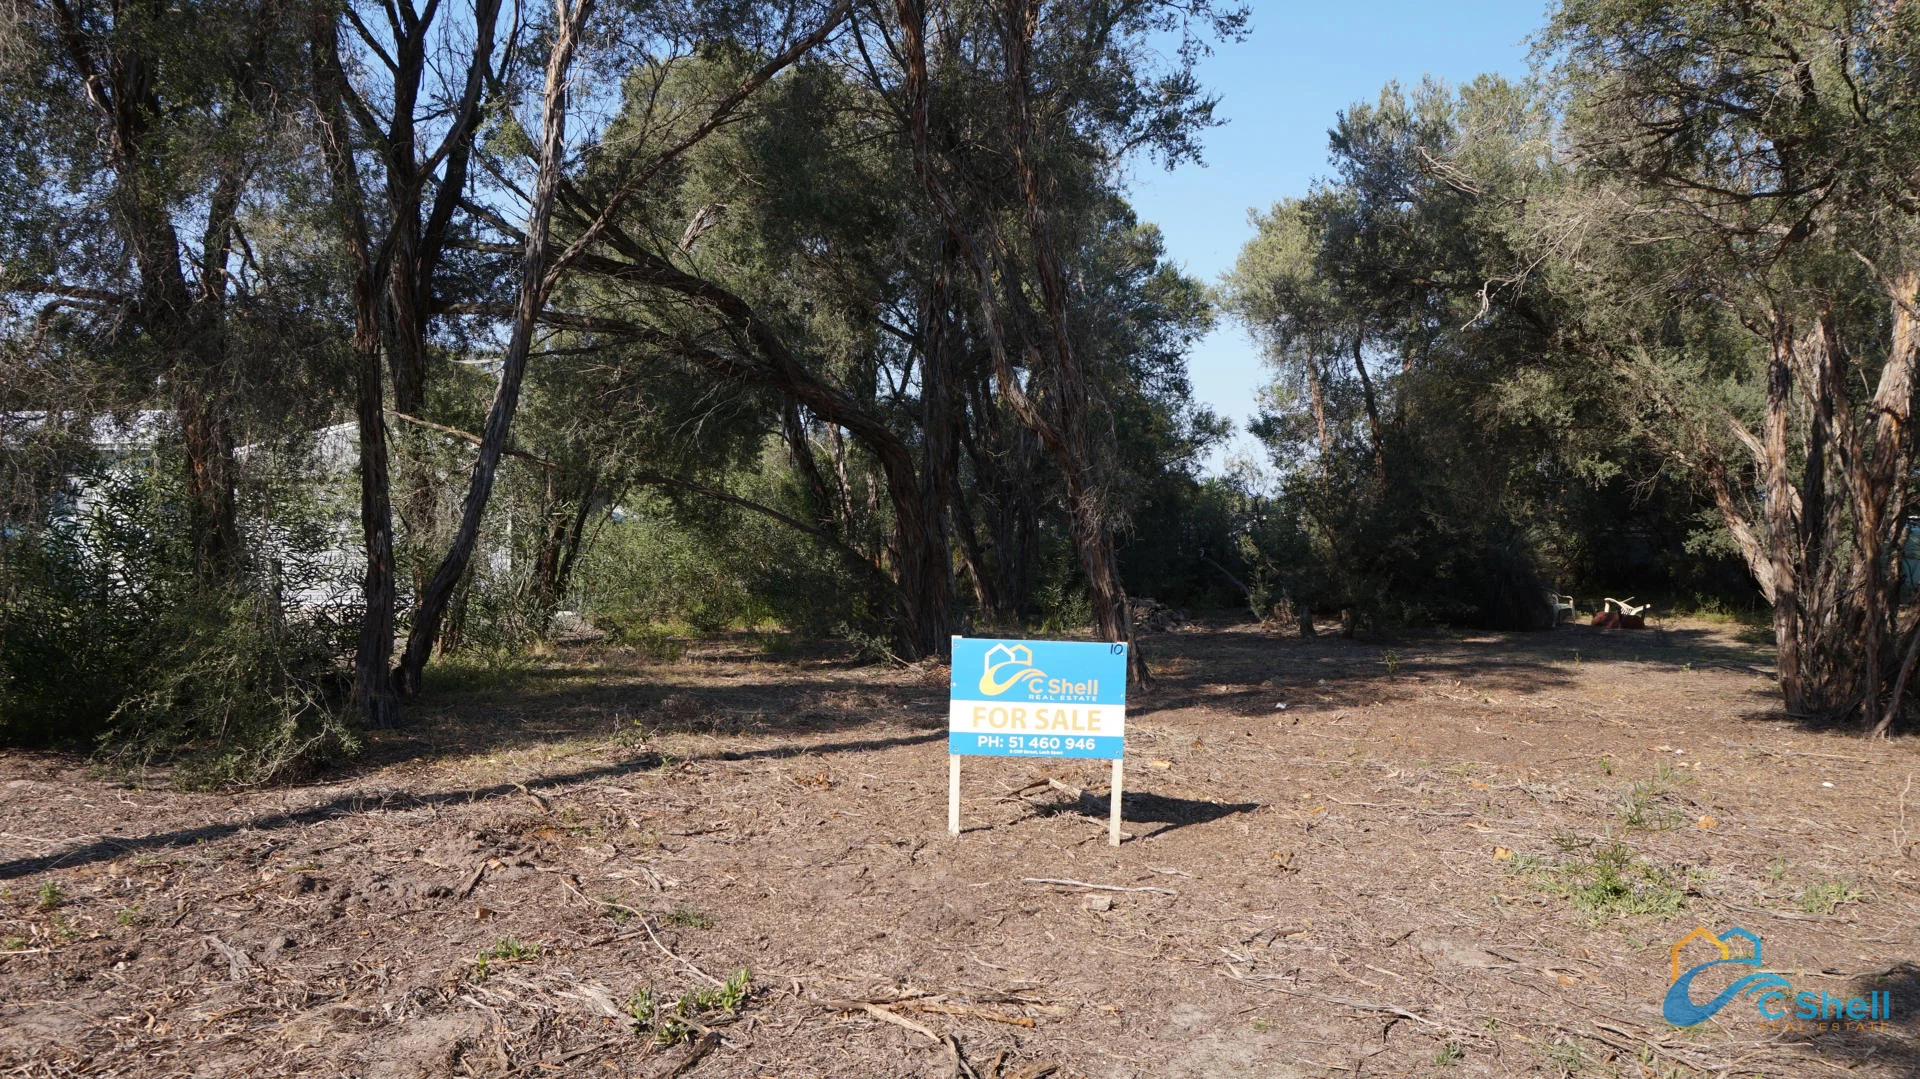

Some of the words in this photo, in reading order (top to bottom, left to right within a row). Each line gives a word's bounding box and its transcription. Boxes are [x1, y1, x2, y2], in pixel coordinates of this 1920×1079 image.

[1110, 643, 1123, 655] 10
[1028, 678, 1043, 694] C
[1048, 678, 1099, 695] Shell
[1059, 694, 1097, 702] ESTATE
[972, 706, 1027, 729] FOR
[1035, 708, 1101, 731] SALE
[977, 735, 1003, 748] PH:
[1008, 736, 1024, 749] 51
[1028, 737, 1060, 749] 460
[1065, 738, 1096, 750] 946
